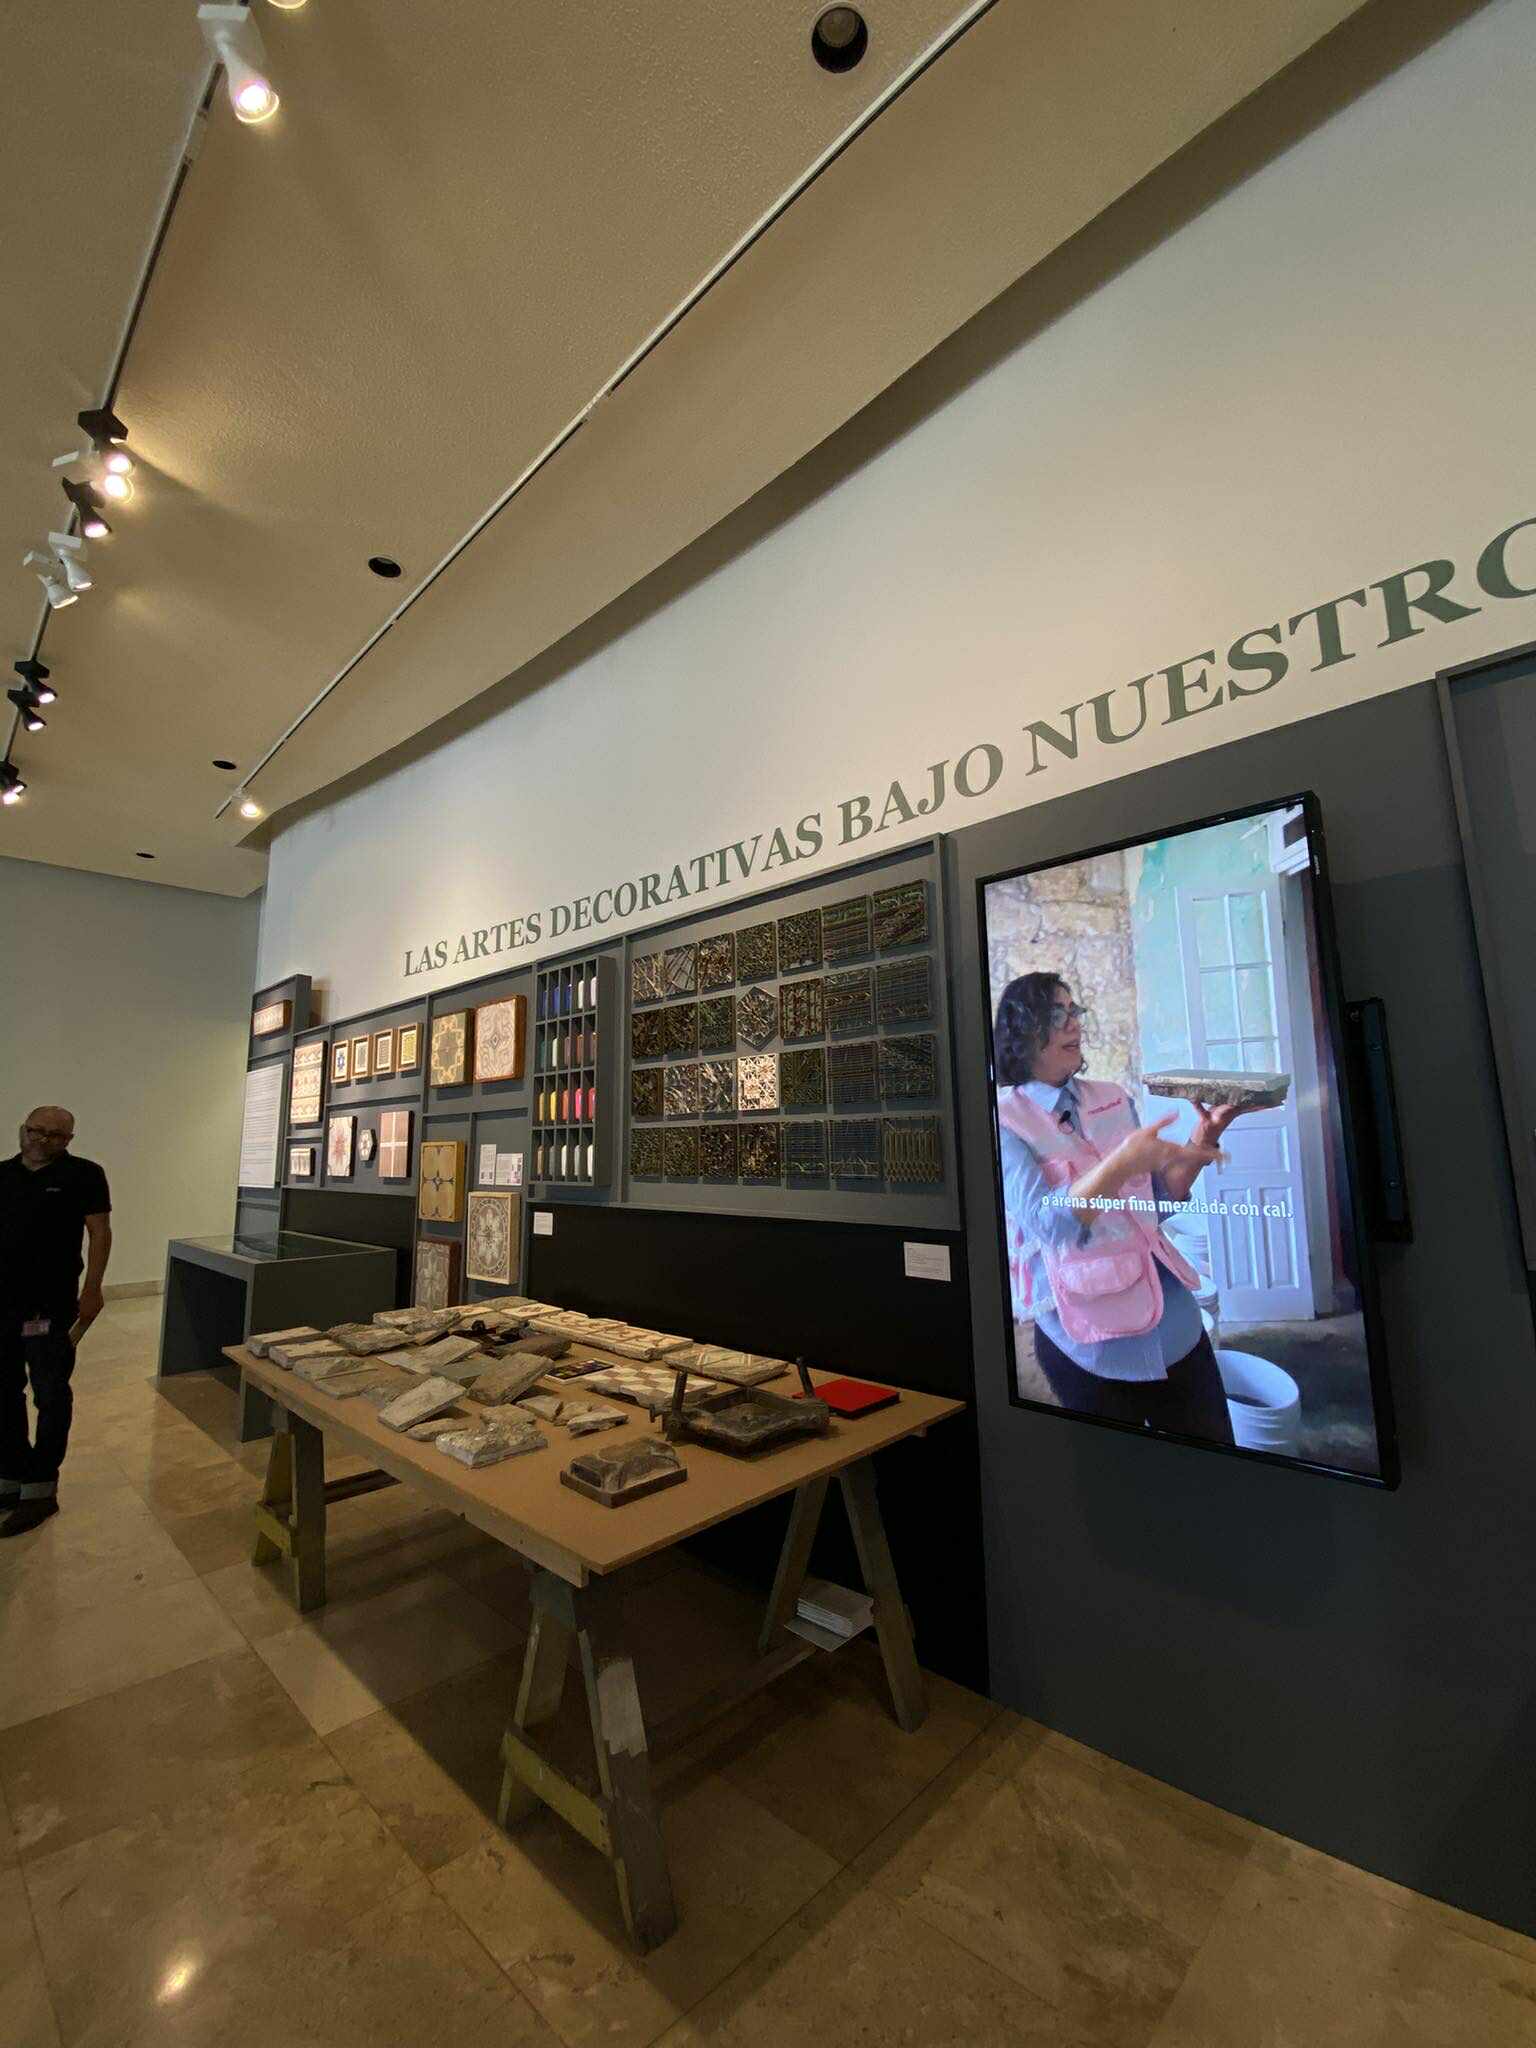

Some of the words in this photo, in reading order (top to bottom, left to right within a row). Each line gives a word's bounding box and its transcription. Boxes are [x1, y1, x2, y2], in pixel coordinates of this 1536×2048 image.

[403, 939, 448, 977] LAS
[452, 912, 542, 965] ARTES
[549, 812, 824, 938] DECORATIVAS
[837, 743, 1004, 846] BAJO
[1042, 1195, 1050, 1206] o
[1052, 1195, 1087, 1209] arena
[1089, 1194, 1126, 1213] súper
[1128, 1195, 1156, 1211] fina
[1159, 1199, 1228, 1215] mezclada
[1232, 1203, 1260, 1217] con
[1263, 1201, 1293, 1218] cal.
